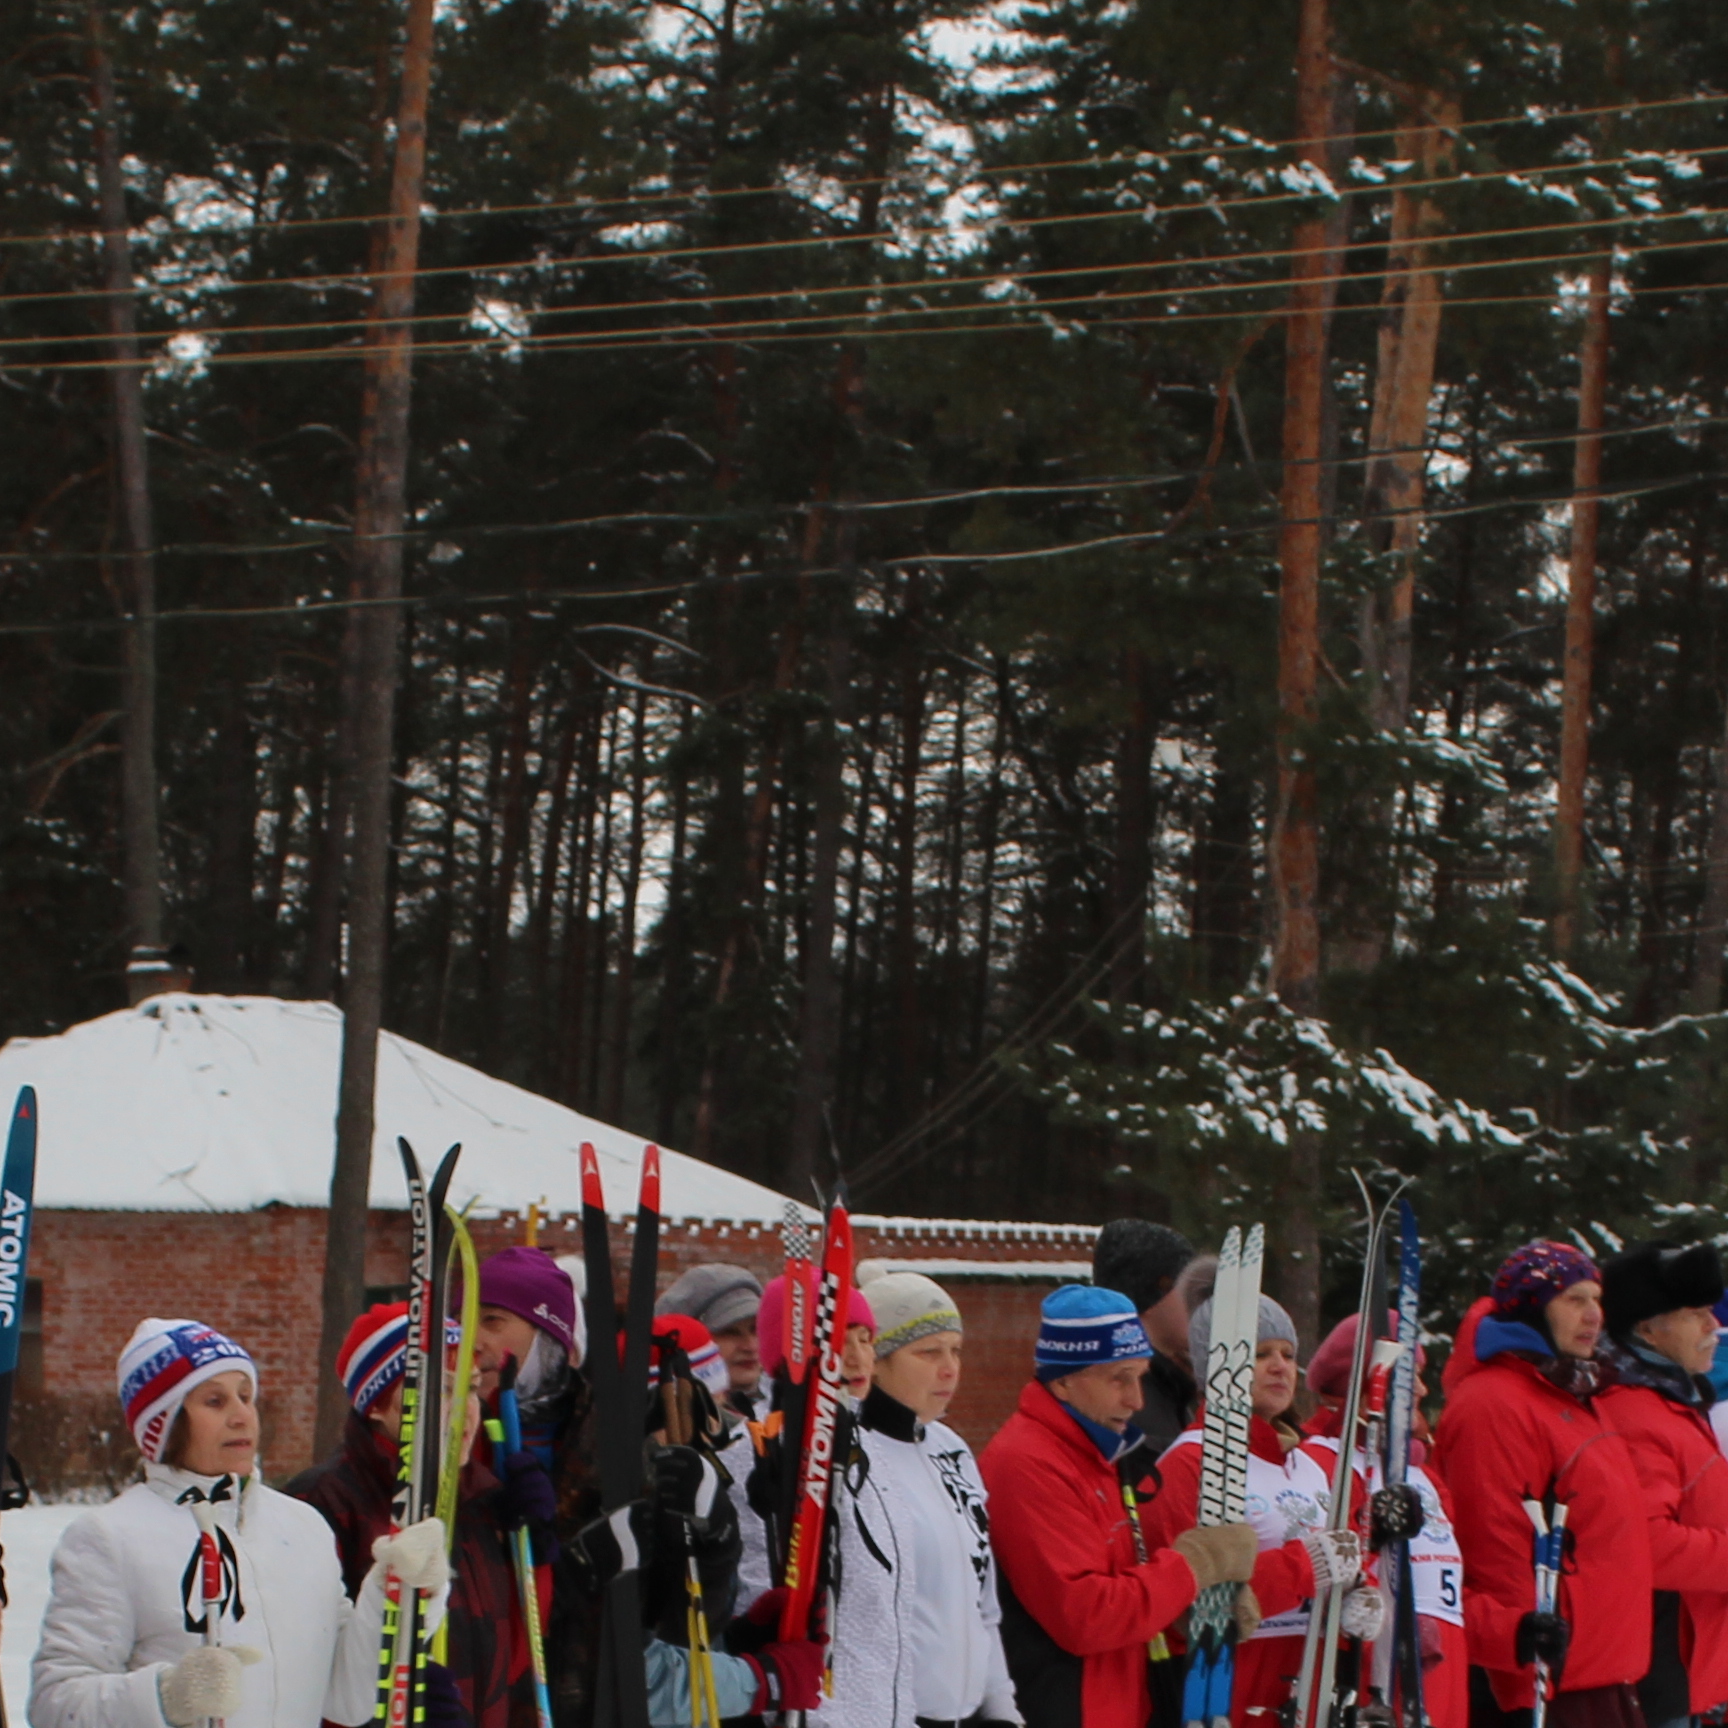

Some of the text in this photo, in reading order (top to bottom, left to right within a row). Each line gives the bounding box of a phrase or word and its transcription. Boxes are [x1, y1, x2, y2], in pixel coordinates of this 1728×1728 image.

[791, 1278, 806, 1365] ATOMIC
[806, 1350, 842, 1508] ATOMIC
[1200, 1412, 1226, 1527] ARHU
[1223, 1409, 1248, 1524] ARHU
[1439, 1569, 1457, 1607] 5
